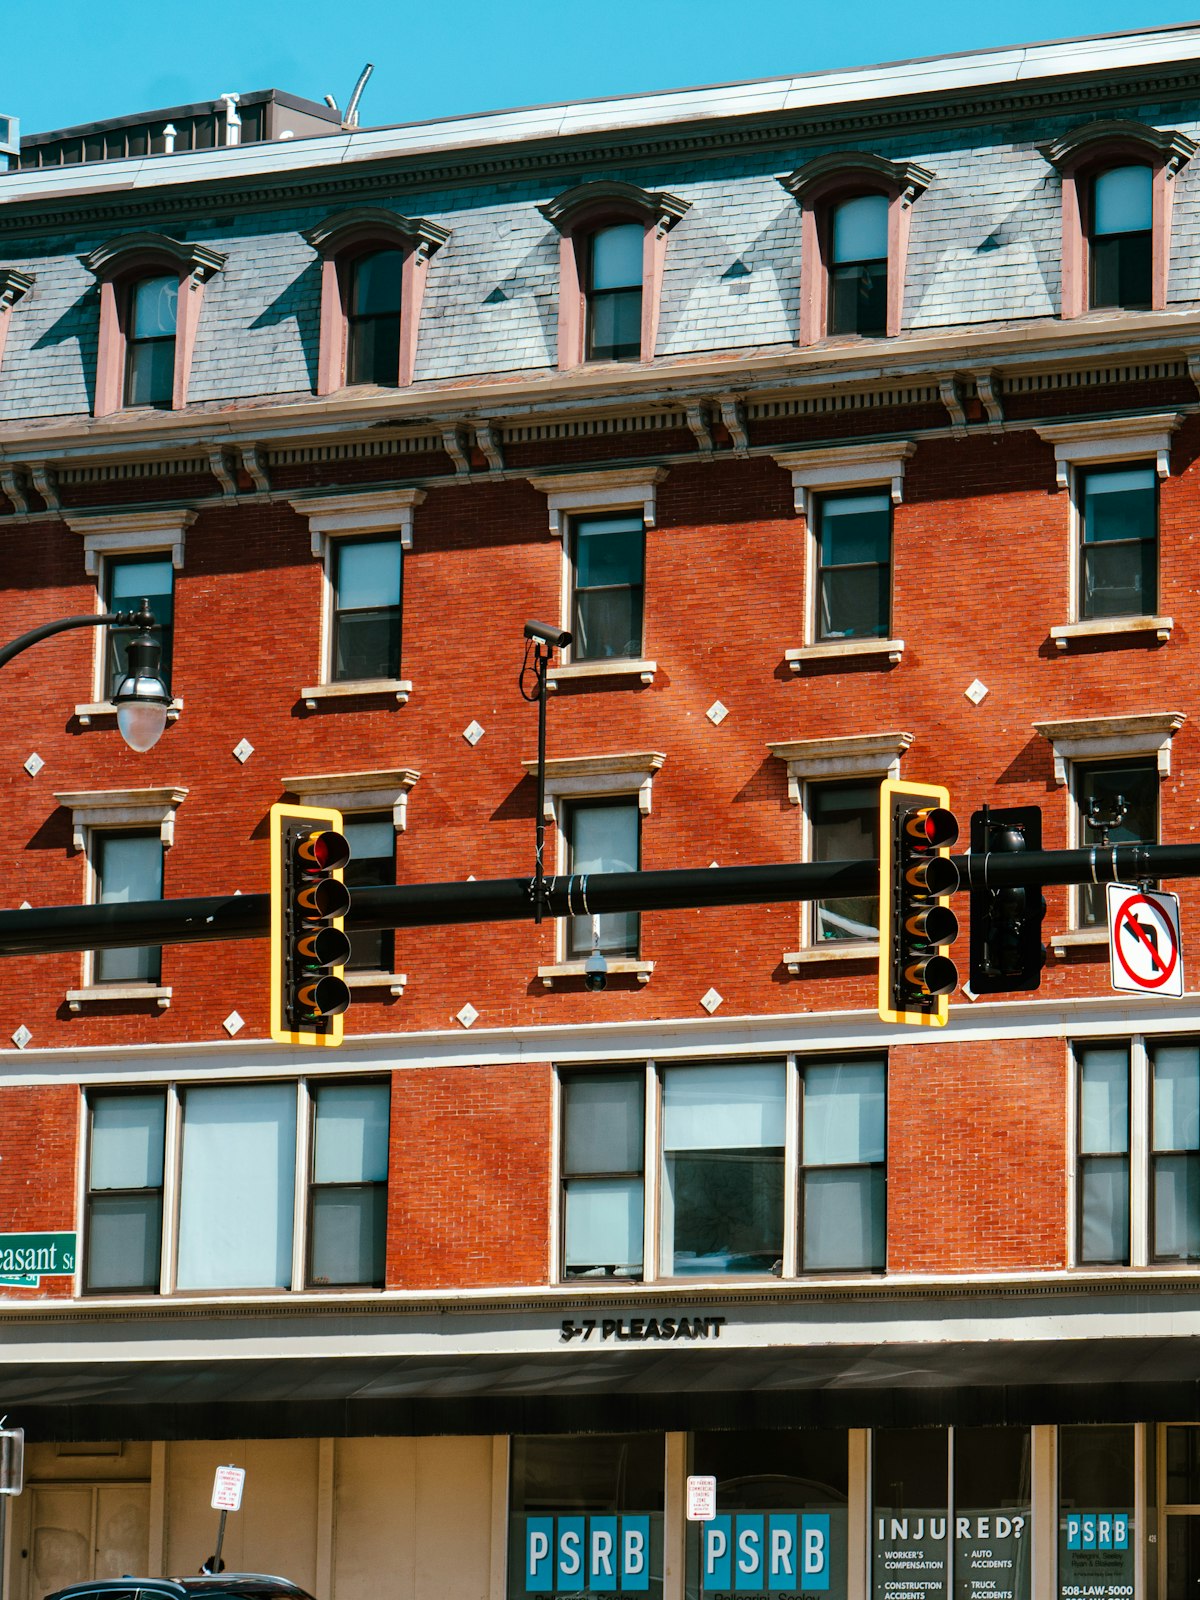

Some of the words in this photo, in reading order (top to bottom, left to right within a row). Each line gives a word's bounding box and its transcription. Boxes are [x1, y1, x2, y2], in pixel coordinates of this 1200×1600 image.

[62, 1253, 74, 1270] St
[561, 1319, 596, 1341] 5-7
[602, 1317, 726, 1340] PLEASANT
[878, 1516, 1025, 1541] INJURED?
[1068, 1520, 1126, 1543] PSRB
[530, 1530, 644, 1576] PSRB
[707, 1529, 825, 1574] PSRB
[884, 1551, 924, 1560] WORKER'S
[971, 1550, 993, 1558] AUTO
[884, 1561, 944, 1570] COMPENSATION
[971, 1560, 1013, 1569] ACCIDENTS
[884, 1581, 942, 1590] CONSTRUCTION
[971, 1581, 996, 1589] TRUCK
[971, 1591, 1013, 1599] ACCIDENTS
[1061, 1585, 1134, 1596] 508-LAW-5000
[884, 1592, 925, 1600] ACCIDENTS
